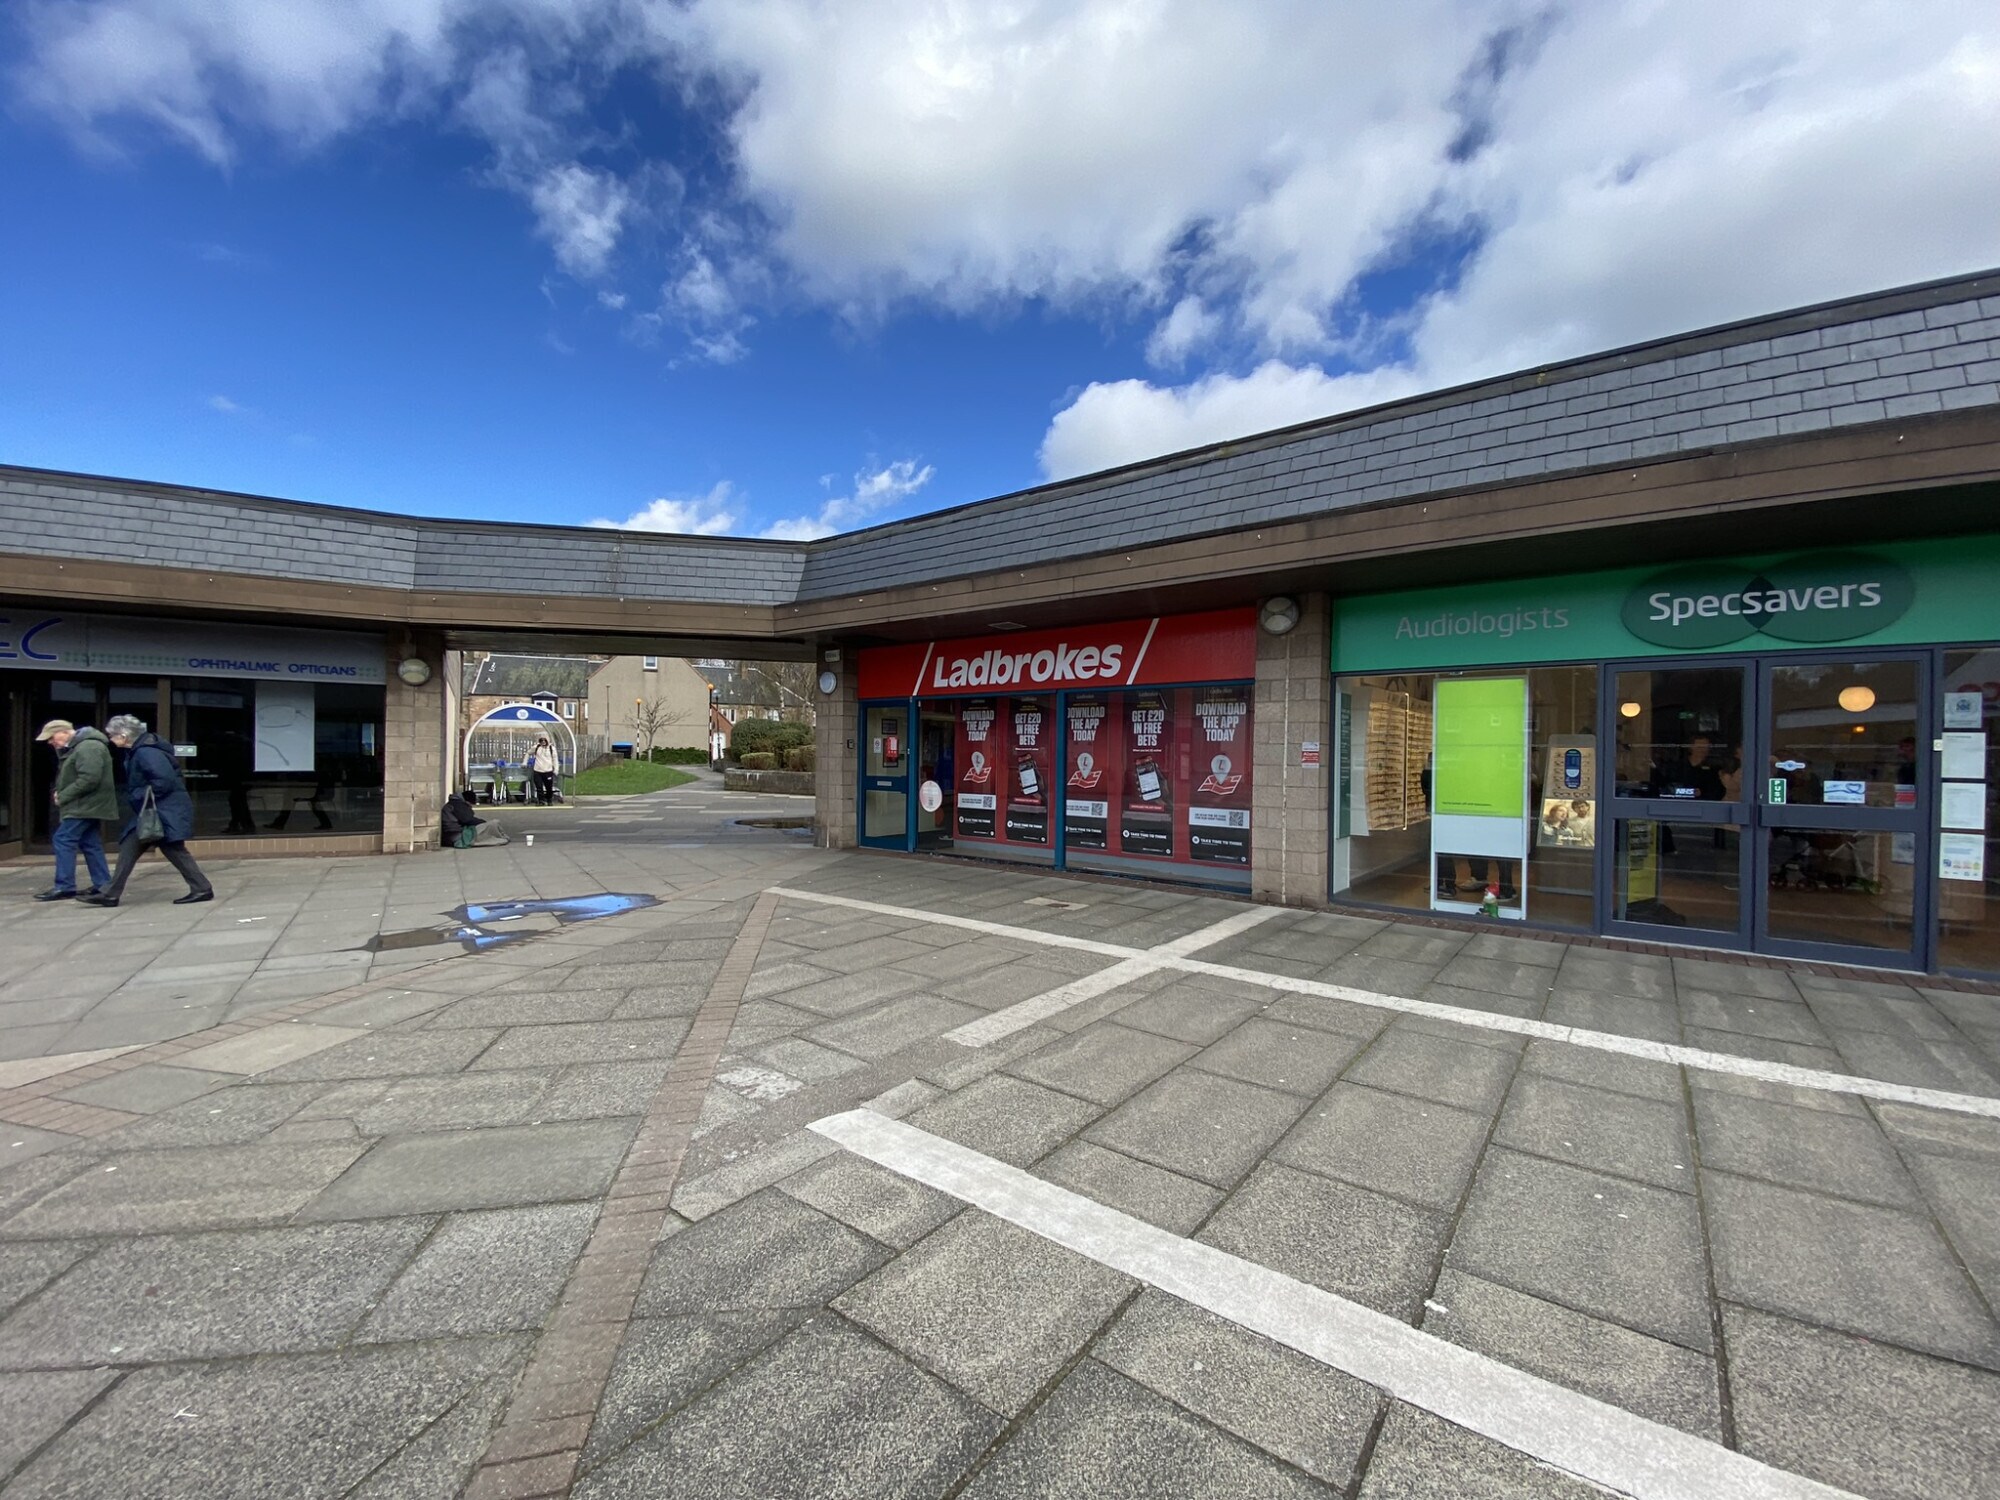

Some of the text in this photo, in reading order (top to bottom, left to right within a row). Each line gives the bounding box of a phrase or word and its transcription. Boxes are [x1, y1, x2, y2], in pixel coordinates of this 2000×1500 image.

[1649, 582, 1881, 626] Specsavers
[1395, 606, 1569, 640] Audiologists
[188, 658, 357, 676] OPHTHALMIC OPTICIANS
[933, 643, 1123, 688] Ladbrokes
[1196, 702, 1247, 716] DOWNLOAD
[962, 710, 994, 721] DOWNLOAD
[1015, 713, 1041, 723] GET £20
[1132, 710, 1164, 722] GET £20
[966, 721, 990, 731] THE APP
[1070, 718, 1099, 730] THE APP
[1134, 722, 1162, 734] IN FREE
[1202, 716, 1239, 729] THE APP
[1016, 724, 1039, 735] IN FREE
[1073, 730, 1097, 741] TODAY
[1206, 729, 1235, 742] TODAY
[968, 731, 987, 741] TODAY
[1019, 735, 1036, 746] BETS
[1137, 735, 1157, 746] BETS
